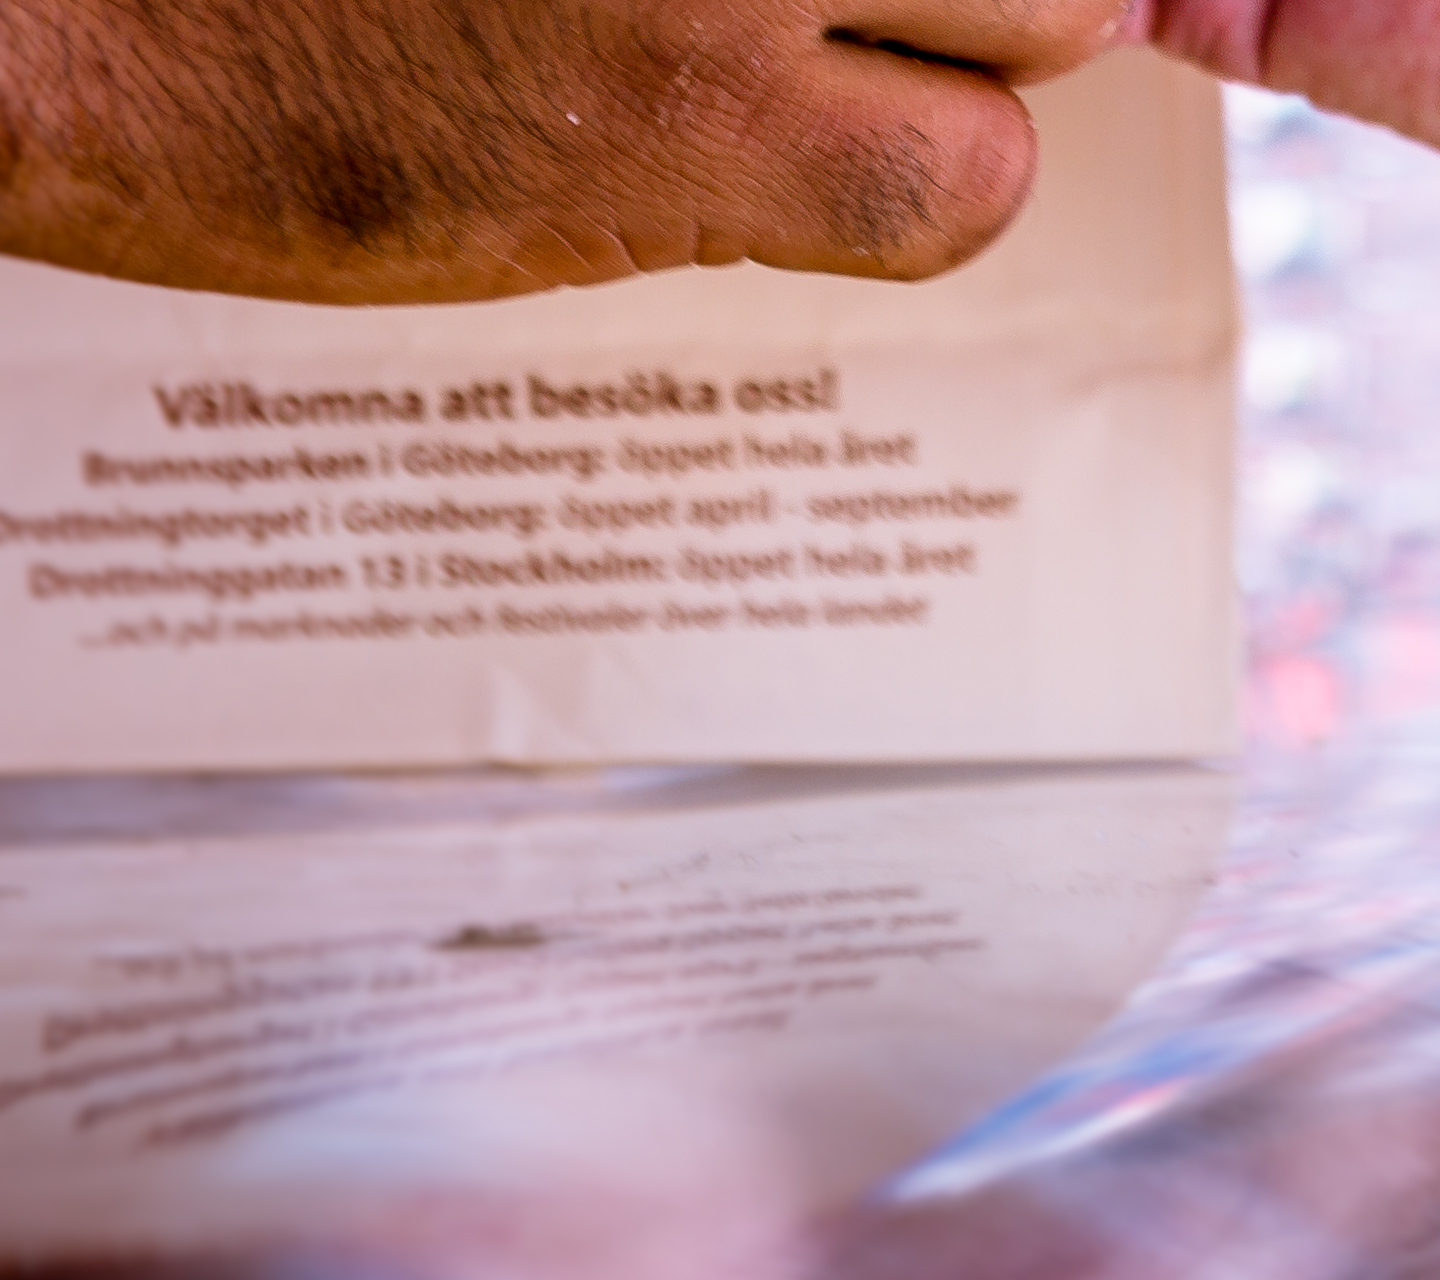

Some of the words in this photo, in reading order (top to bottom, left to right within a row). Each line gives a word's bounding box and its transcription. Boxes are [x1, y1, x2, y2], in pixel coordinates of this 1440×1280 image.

[153, 381, 427, 428] Välkomna
[440, 380, 514, 422] att
[526, 371, 722, 419] besöka
[732, 367, 838, 414] oss!
[82, 448, 368, 488] Brunnsparken
[616, 439, 736, 474] öppet
[742, 435, 828, 467] hela
[838, 431, 916, 466] året
[557, 496, 676, 532] öppet
[685, 489, 774, 530] april
[807, 487, 1019, 524] september
[29, 562, 348, 602] Drottninggatan
[360, 553, 408, 590] 13
[675, 548, 795, 583] öppet
[804, 545, 891, 576] hela
[896, 542, 975, 575] året
